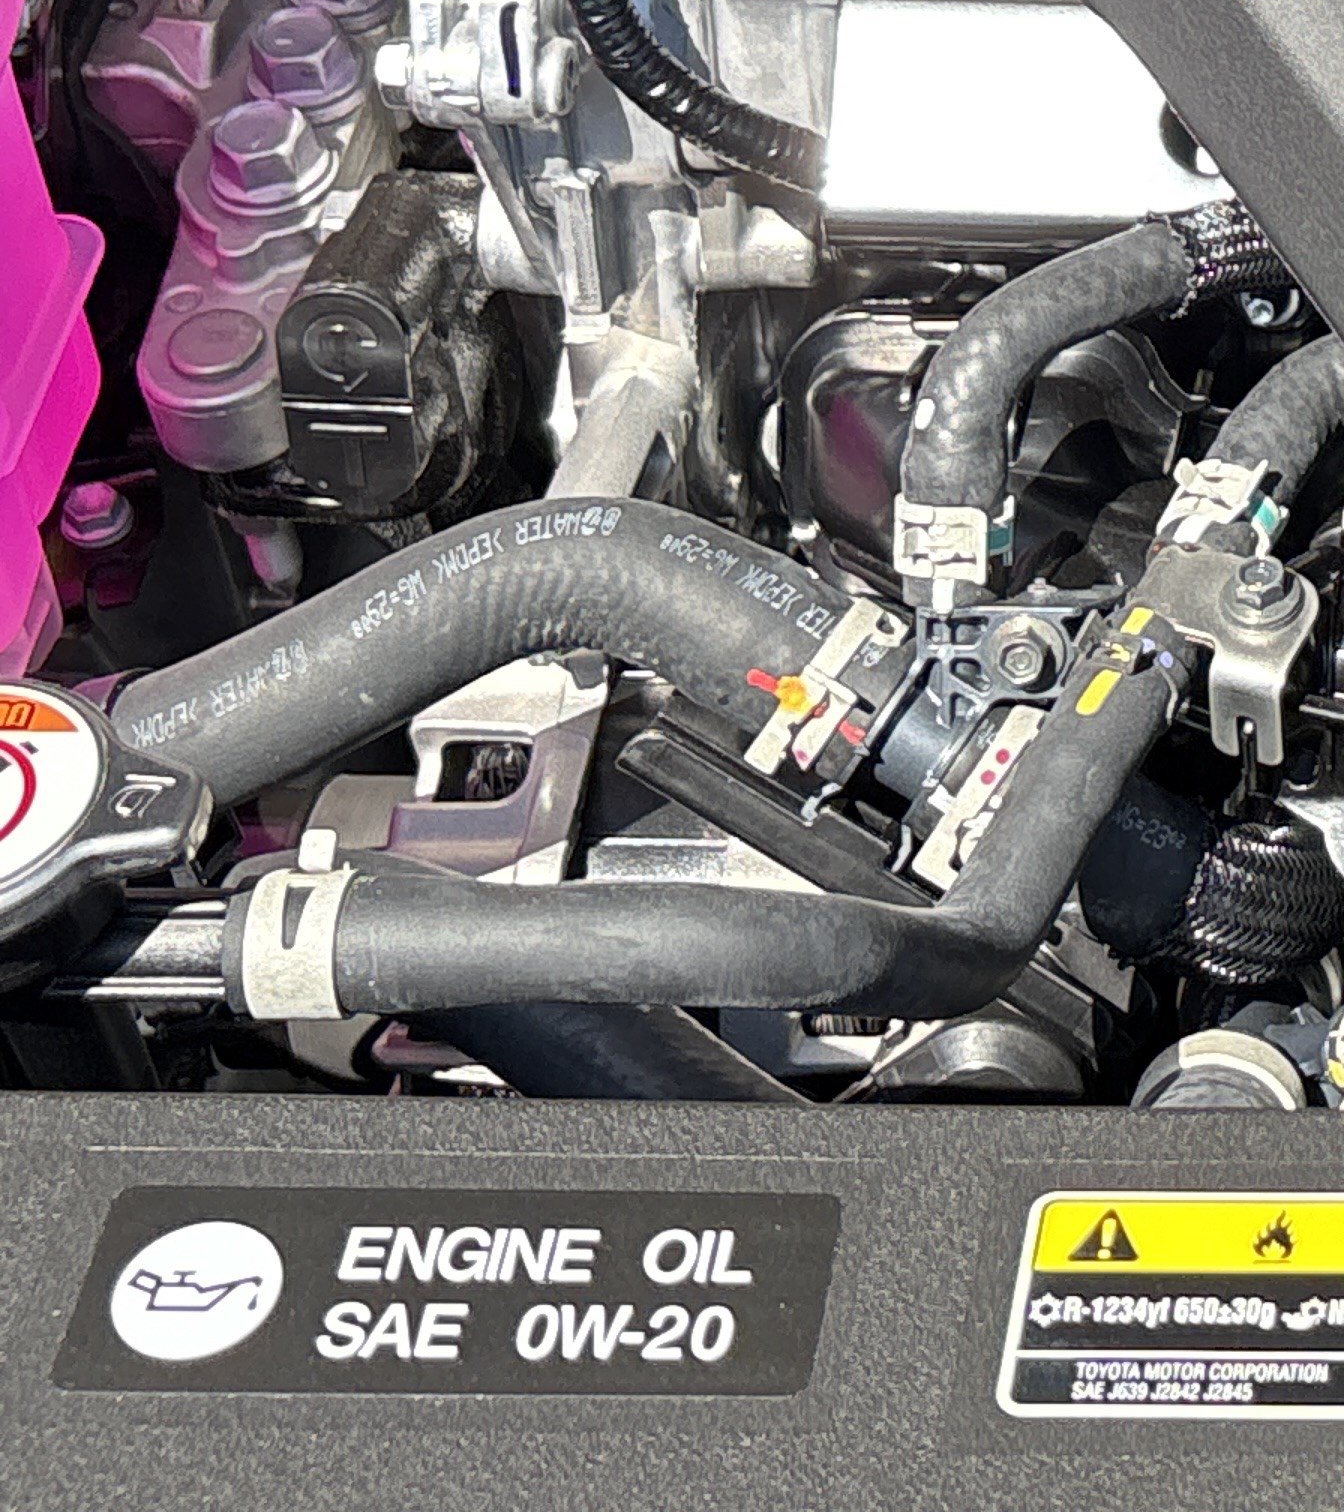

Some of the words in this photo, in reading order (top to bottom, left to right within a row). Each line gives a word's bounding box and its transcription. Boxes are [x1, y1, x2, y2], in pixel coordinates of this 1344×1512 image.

[338, 1226, 601, 1285] ENGINE
[641, 1227, 753, 1286] OIL
[1062, 1294, 1171, 1330] R-1234yf
[1172, 1295, 1277, 1331] 650±30g
[315, 1302, 470, 1361] SAE
[514, 1303, 737, 1363] 0W-20
[1075, 1361, 1141, 1381] TOYOTA
[1143, 1362, 1207, 1381] MOTOR
[1208, 1362, 1330, 1384] CORPORATION
[1070, 1381, 1106, 1401] SAE
[1107, 1382, 1149, 1402] J639
[1150, 1382, 1201, 1402] J2842
[1202, 1382, 1254, 1403] J2845
